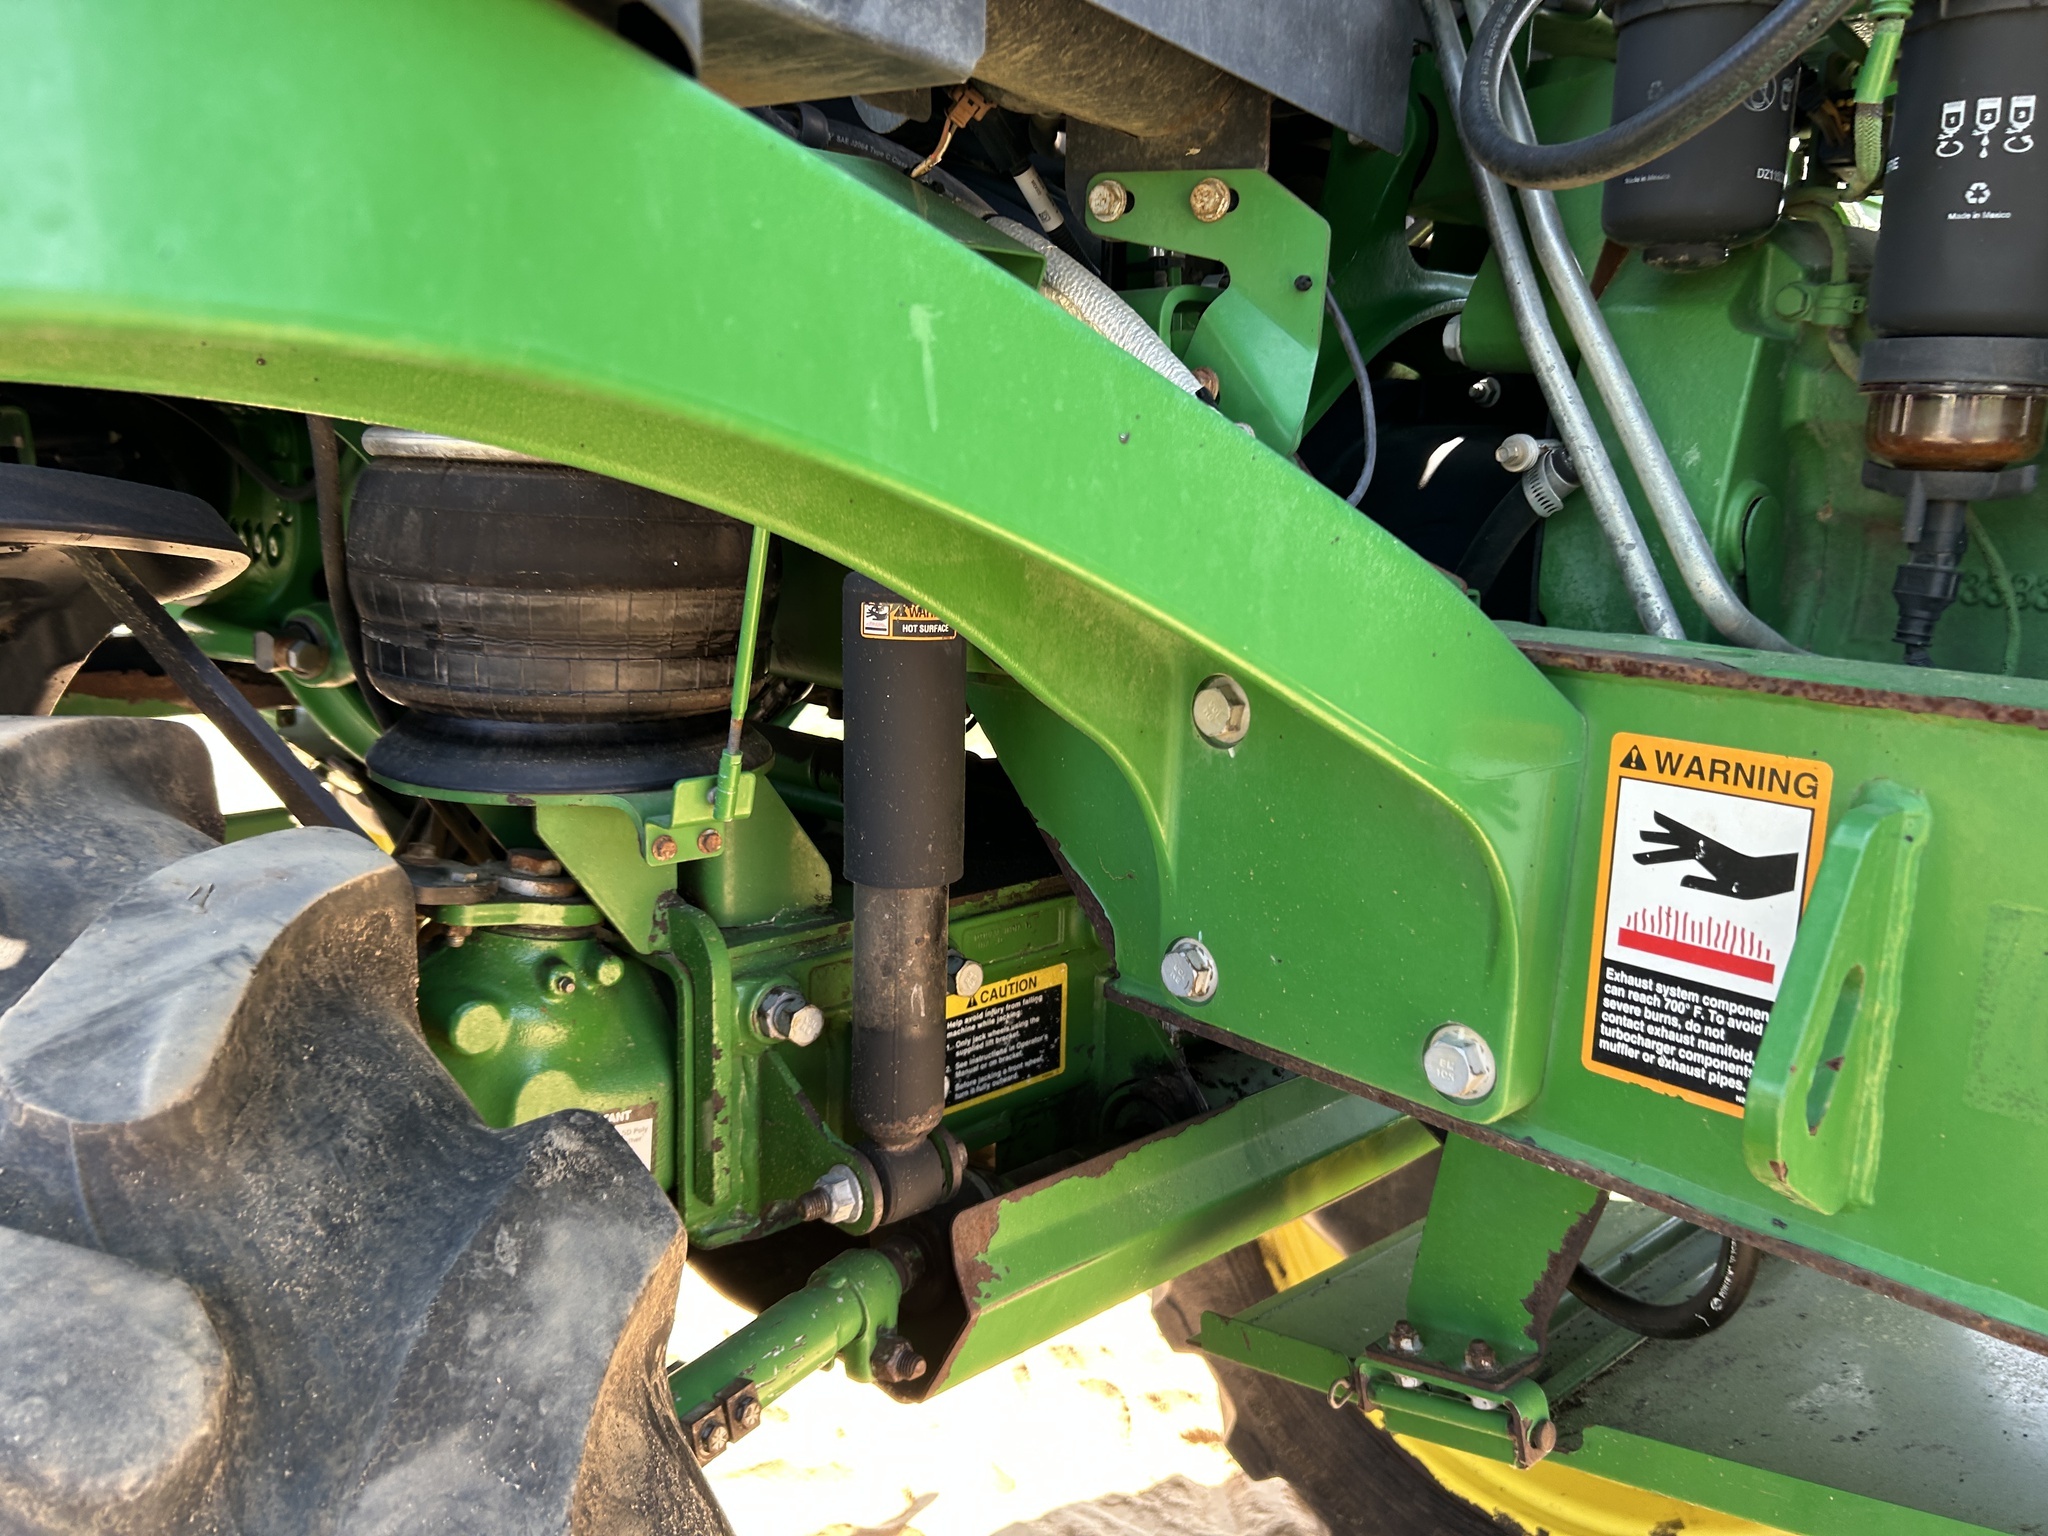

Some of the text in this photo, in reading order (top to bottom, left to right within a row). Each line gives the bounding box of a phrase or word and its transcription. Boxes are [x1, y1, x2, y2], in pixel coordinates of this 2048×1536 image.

[1983, 112, 1992, 121] 2
[1947, 210, 2012, 220] Made in Mexico
[902, 624, 949, 633] HOT SURFACE
[1655, 749, 1819, 800] WARNING
[980, 976, 1037, 1004] CAUTION
[1605, 967, 1770, 1023] Exhaust system componen
[947, 994, 1043, 1030] Help avoid injury from falling
[1602, 997, 1726, 1041] severe burns, do not
[1604, 983, 1764, 1037] can reach 700° F. To avoid
[947, 1024, 976, 1039] machine
[977, 1018, 995, 1029] while
[955, 1037, 972, 1049] Only
[972, 1033, 986, 1043] jack
[987, 1026, 1010, 1038] wheels
[1010, 1020, 1029, 1031] using
[1030, 1016, 1040, 1025] the
[1600, 1024, 1676, 1057] turbocharger
[1601, 1011, 1755, 1066] contact exhaust manifold,
[955, 1042, 984, 1057] supplied
[955, 1061, 968, 1071] See
[969, 1047, 1007, 1065] instructions
[955, 1064, 979, 1079] Manual
[988, 1060, 998, 1068] on
[978, 1071, 1001, 1086] jacking
[1008, 1062, 1024, 1072] front
[1599, 1038, 1746, 1092] muffler or exhaust pipes.
